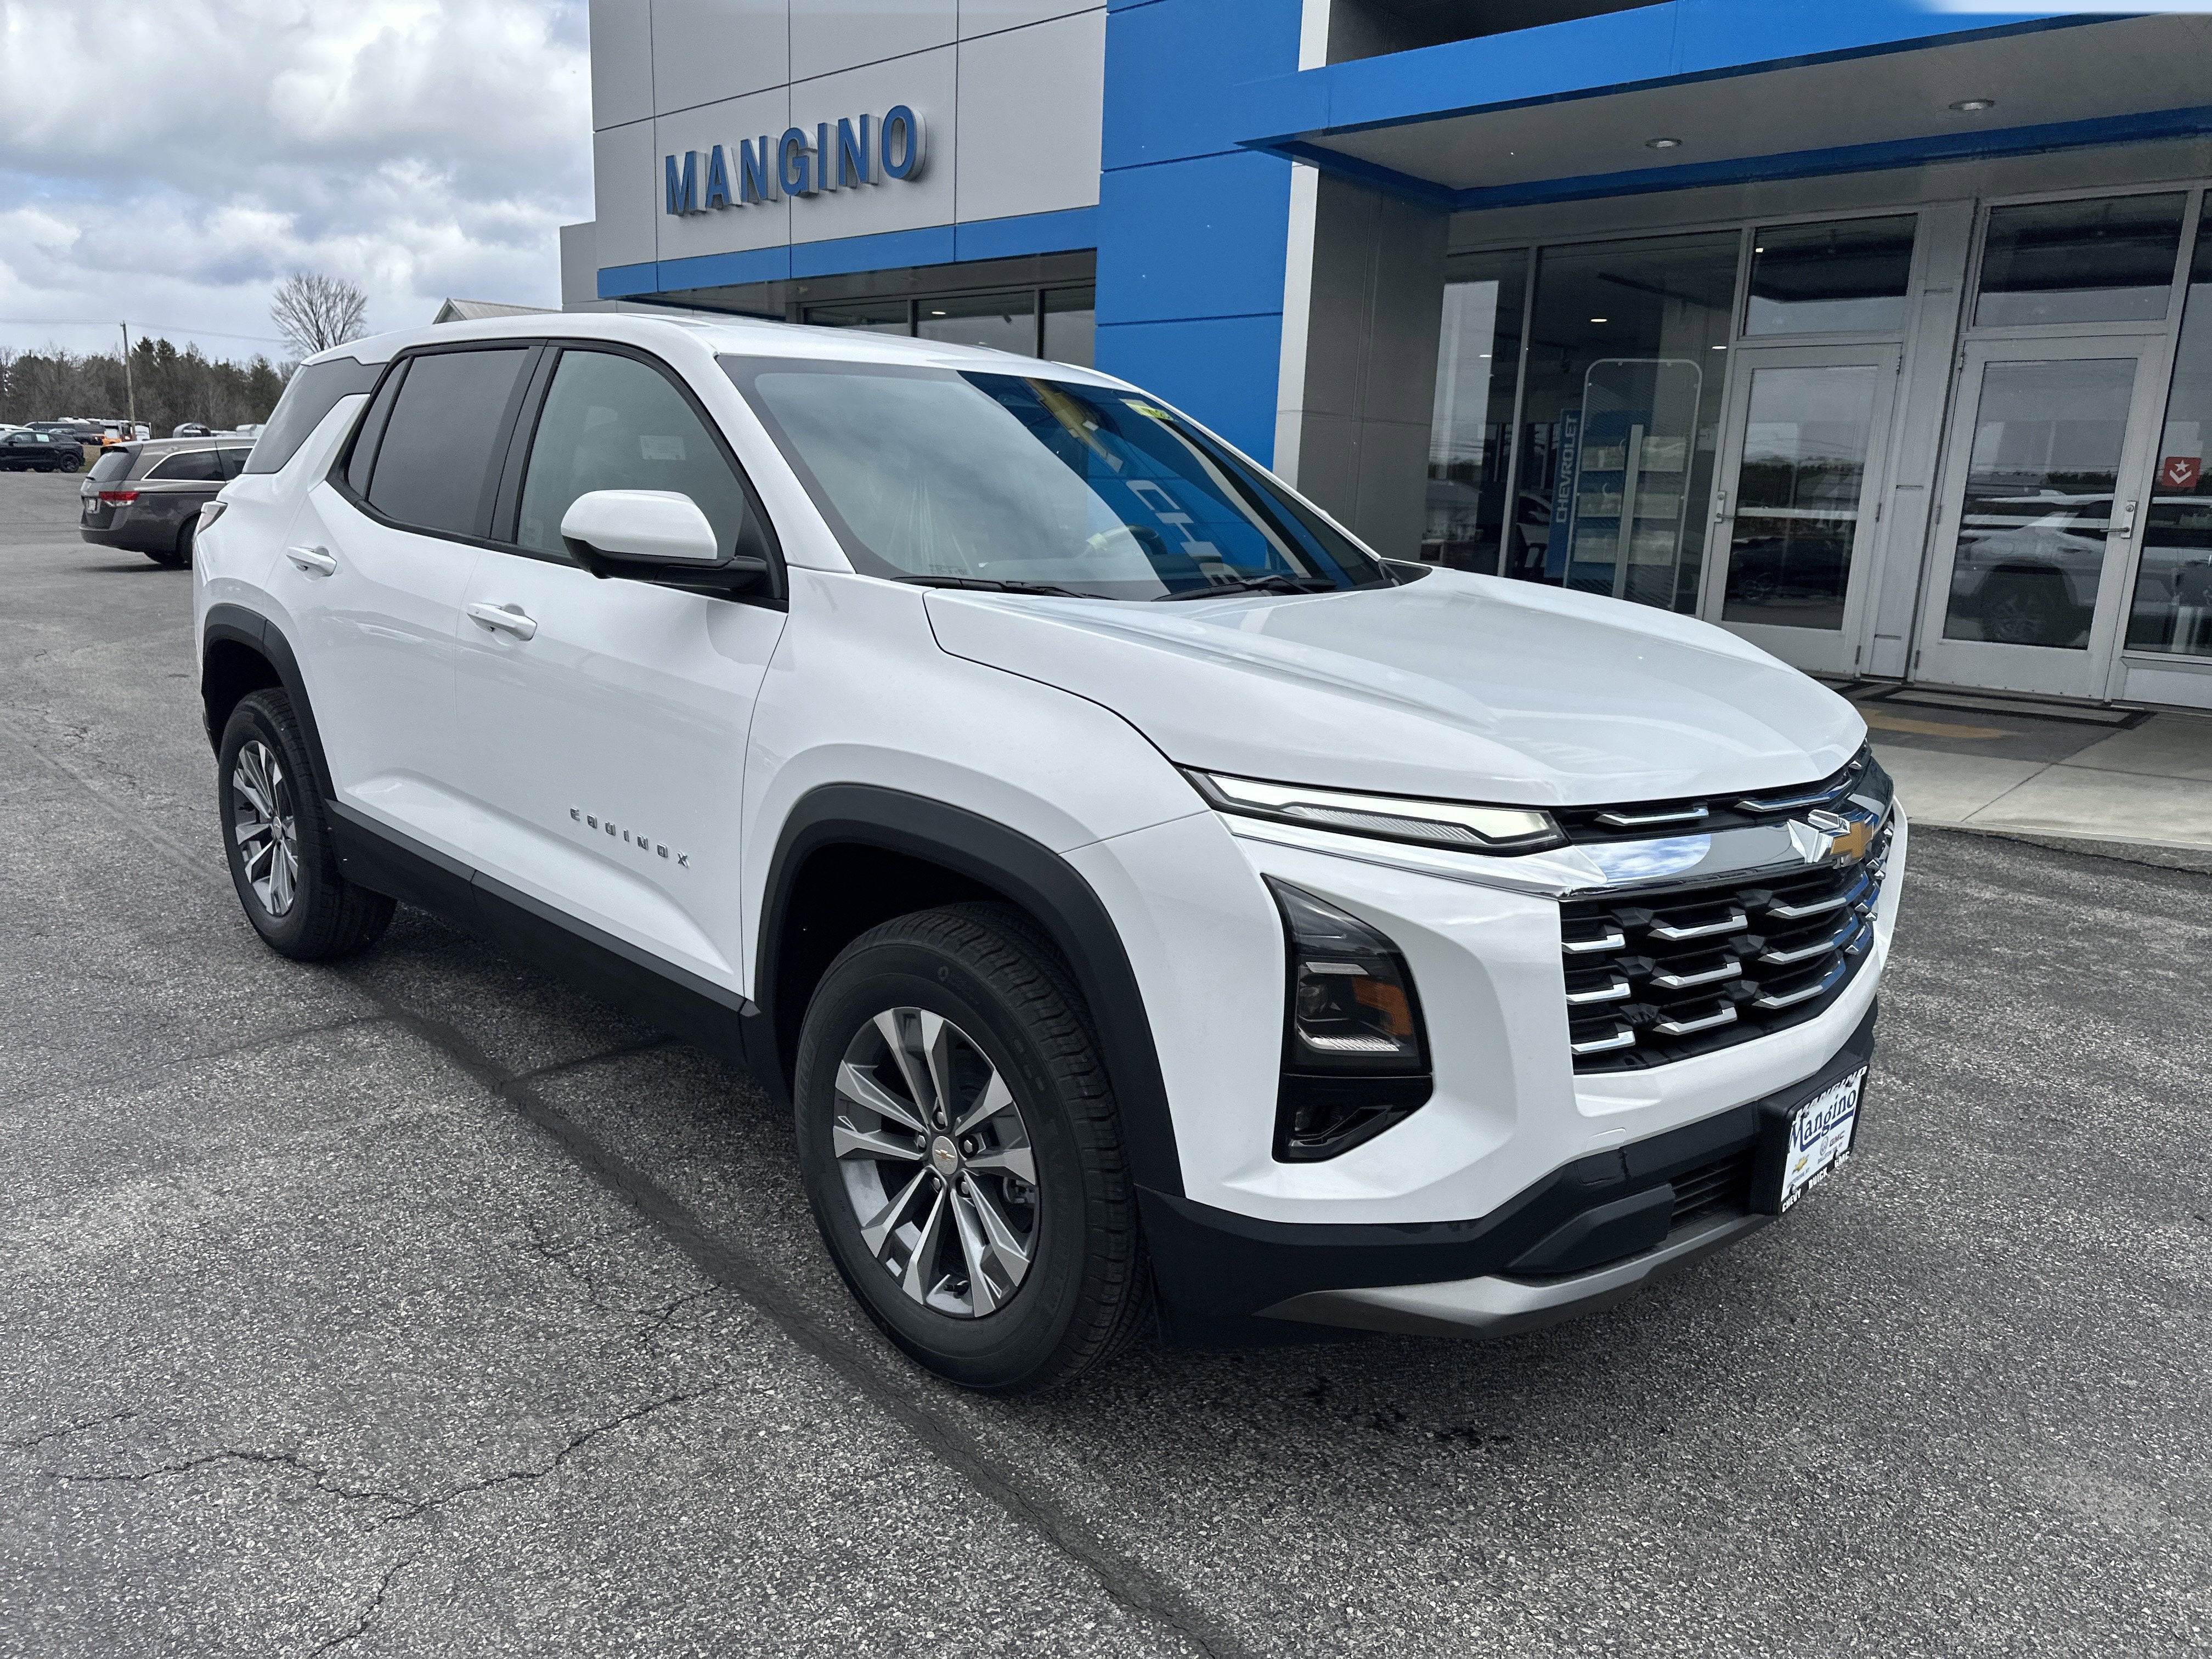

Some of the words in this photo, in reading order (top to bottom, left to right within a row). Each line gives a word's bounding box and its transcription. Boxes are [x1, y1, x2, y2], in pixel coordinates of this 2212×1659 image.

[665, 104, 925, 216] MANGINO
[1555, 414, 1579, 523] CHEVROLET
[569, 807, 690, 868] EQUINOX
[1790, 1088, 1857, 1152] Mangino
[1782, 1189, 1802, 1212] CHEVY
[1808, 1167, 1828, 1189] BUICK
[1834, 1150, 1850, 1168] GMC
